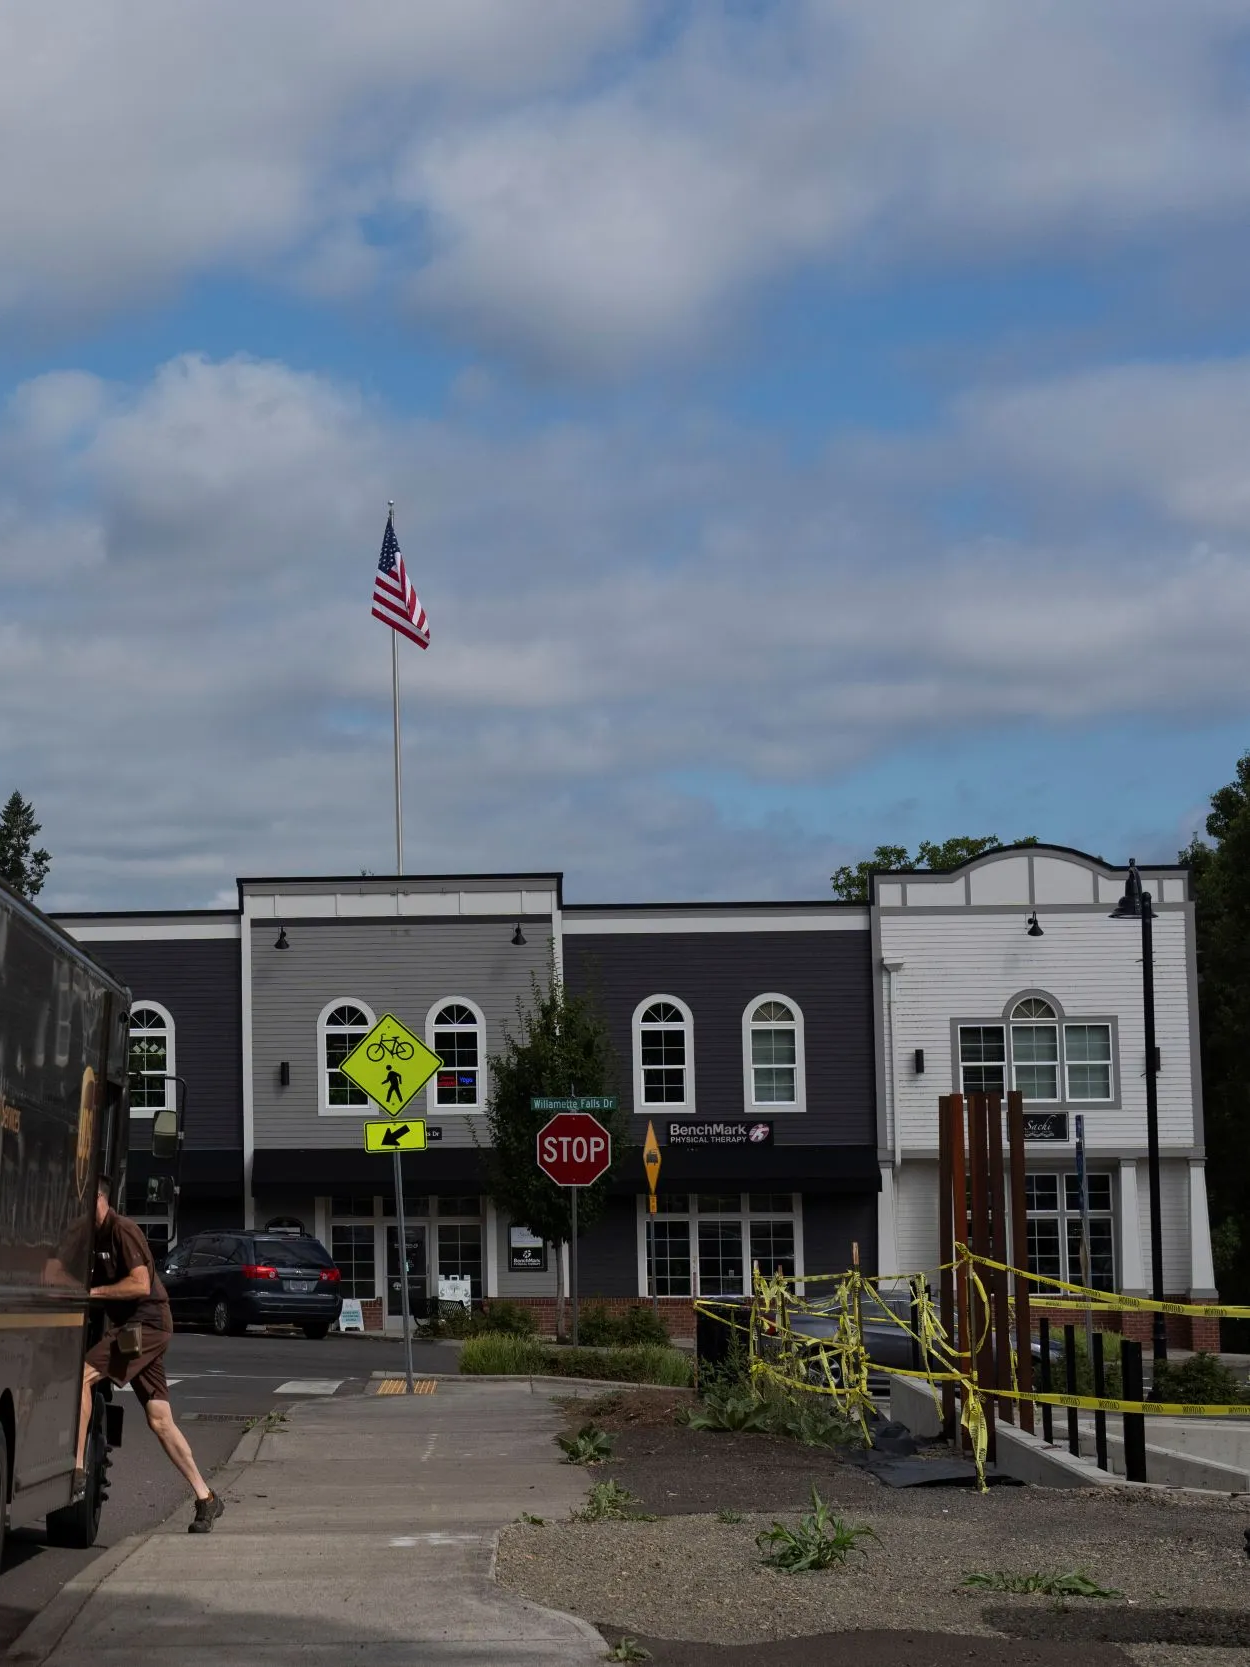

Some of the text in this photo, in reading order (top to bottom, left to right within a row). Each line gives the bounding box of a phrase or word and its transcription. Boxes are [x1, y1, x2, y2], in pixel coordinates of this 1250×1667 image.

[533, 1099, 613, 1109] Willamette Falls Dr
[1026, 1114, 1057, 1131] Sachi
[670, 1123, 747, 1135] BenchMark
[670, 1136, 709, 1144] PHYSICAL
[543, 1136, 605, 1163] STOP
